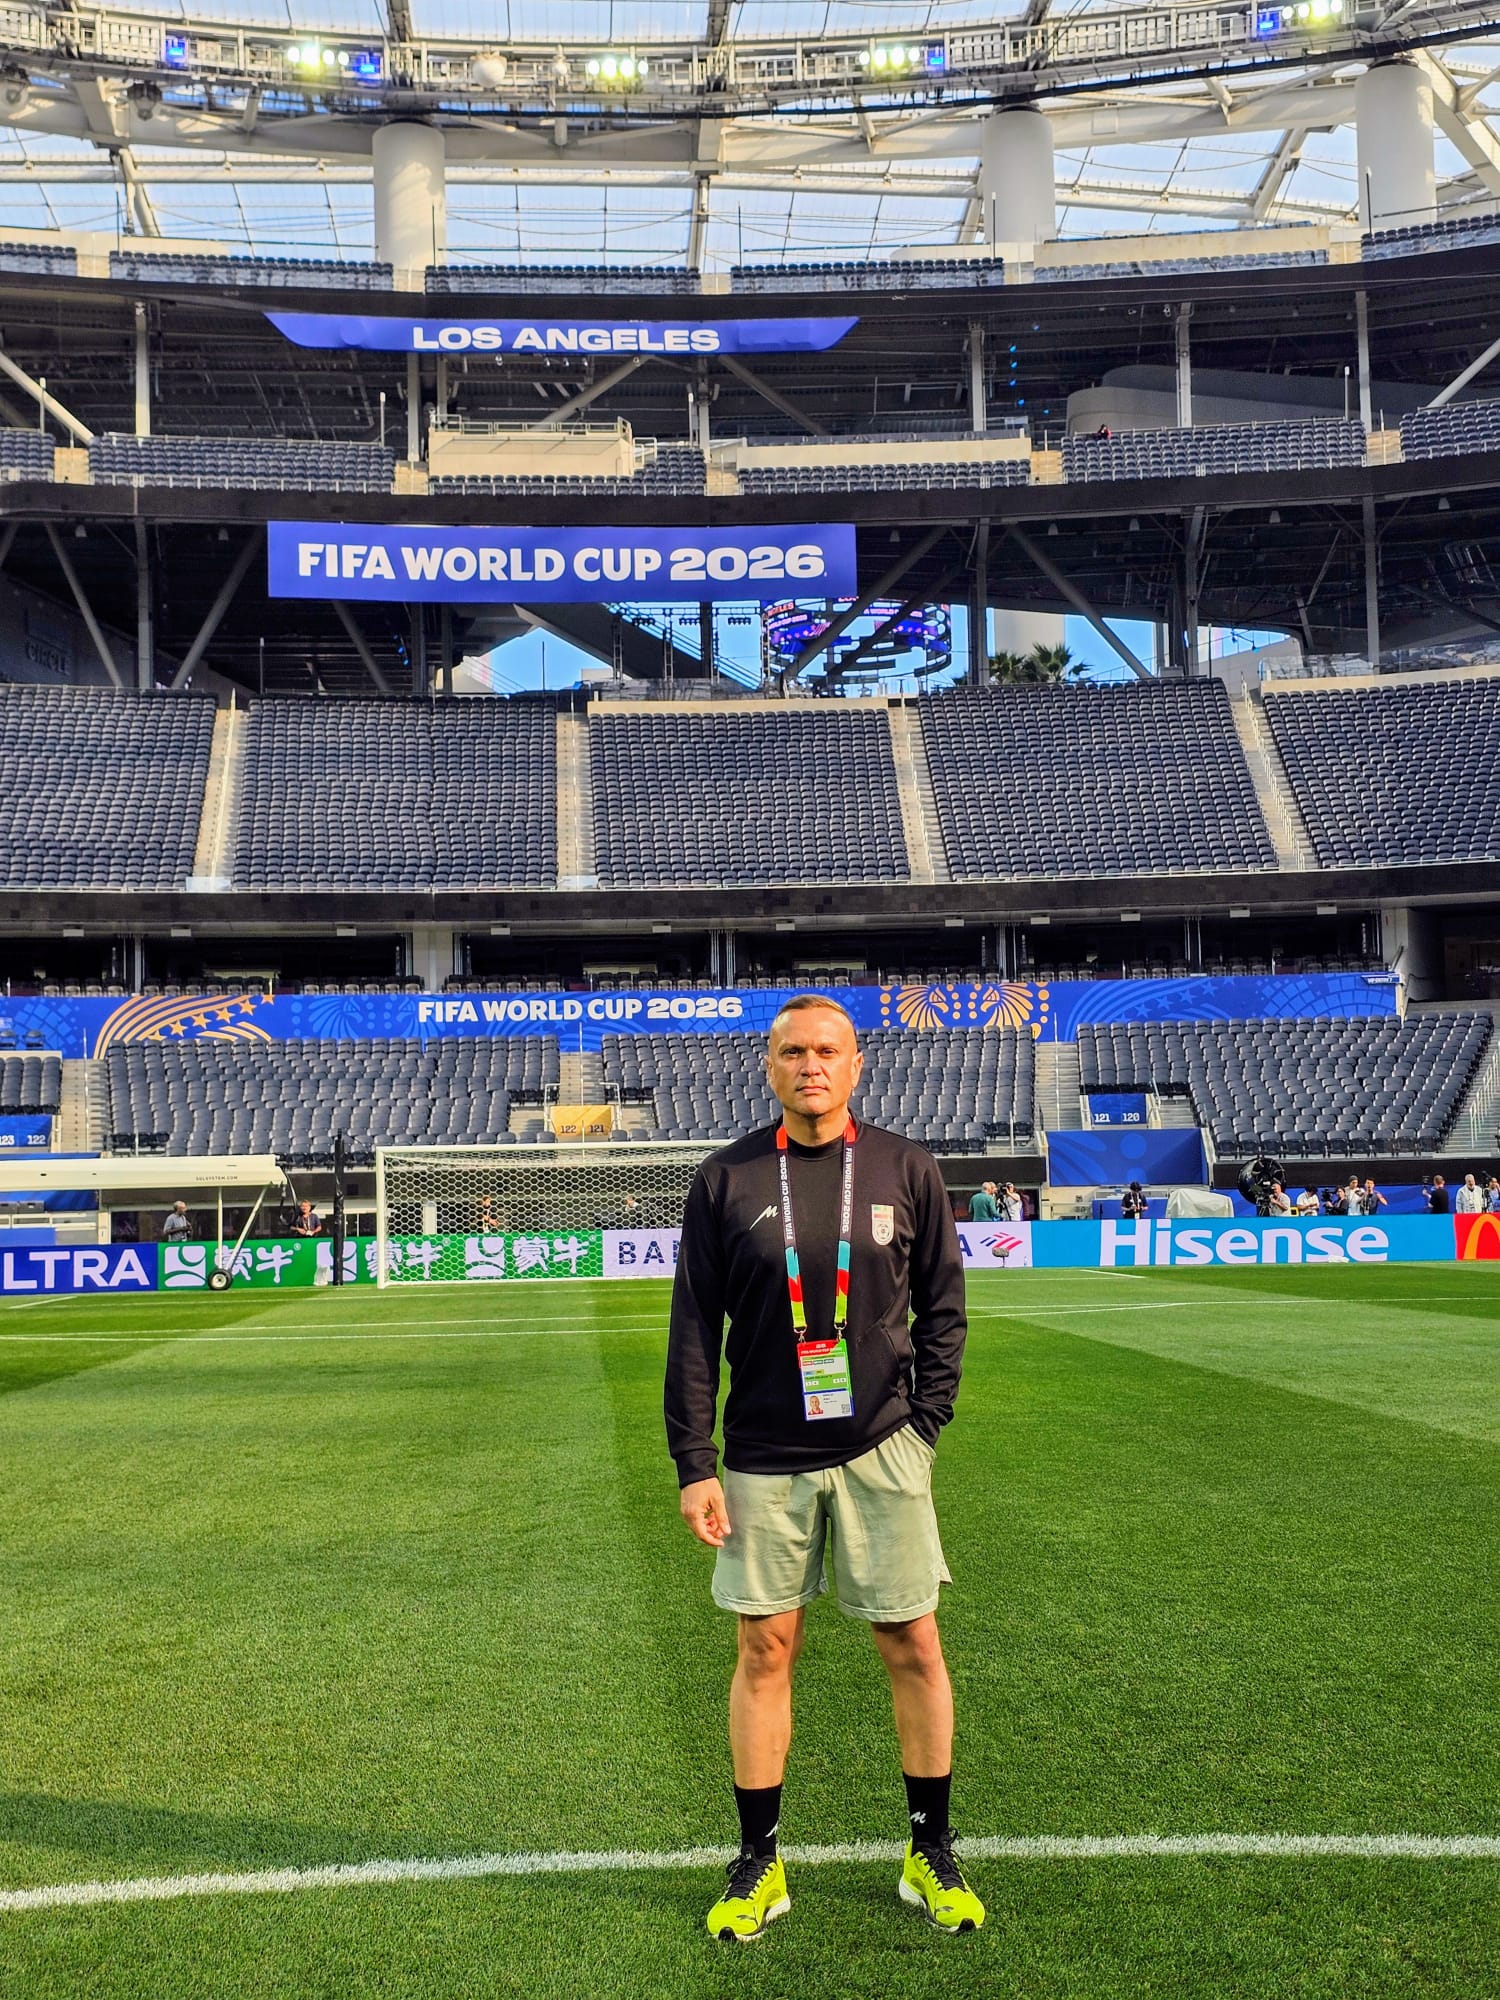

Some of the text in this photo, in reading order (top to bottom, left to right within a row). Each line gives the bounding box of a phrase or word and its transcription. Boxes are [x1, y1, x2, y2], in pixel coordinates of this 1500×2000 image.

[412, 326, 720, 351] LOS ANGELES
[298, 543, 825, 582] FIFA WORLD CUP 2026
[418, 997, 743, 1023] FIFA WORLD CUP 2026
[1094, 1112, 1140, 1123] 121 120
[561, 1124, 604, 1134] 122 121
[0, 1134, 46, 1146] 23 122
[845, 1147, 853, 1163] FIFA
[781, 1180, 789, 1196] CUP
[843, 1189, 851, 1206] CUP
[783, 1195, 791, 1223] WORLD
[785, 1222, 793, 1240] FIFA
[1099, 1218, 1389, 1266] Hisense
[3, 1249, 150, 1290] LTRA
